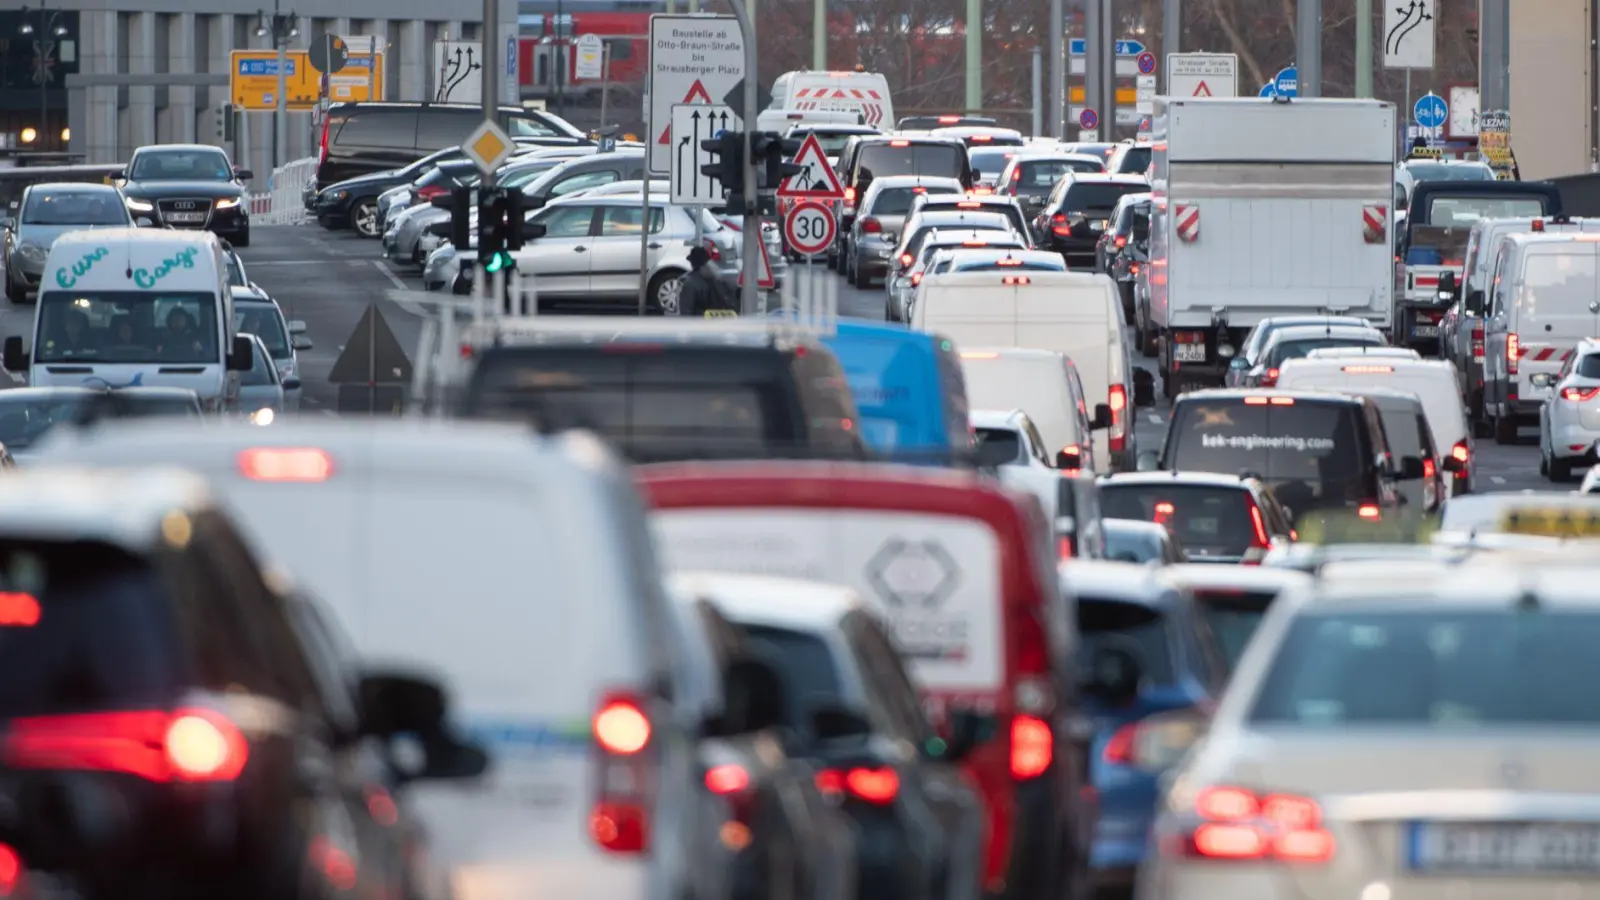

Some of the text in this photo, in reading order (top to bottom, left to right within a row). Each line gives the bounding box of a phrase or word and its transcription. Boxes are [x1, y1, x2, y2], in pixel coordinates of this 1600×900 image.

[672, 29, 727, 39] Baustelle ab
[657, 41, 741, 51] Otto-Braun-Straße
[692, 54, 705, 62] bis
[657, 64, 740, 75] Strausberger Platz
[796, 216, 825, 239] 30
[56, 246, 198, 289] Euro Cargo
[1202, 433, 1335, 451] kek-engineering.com
